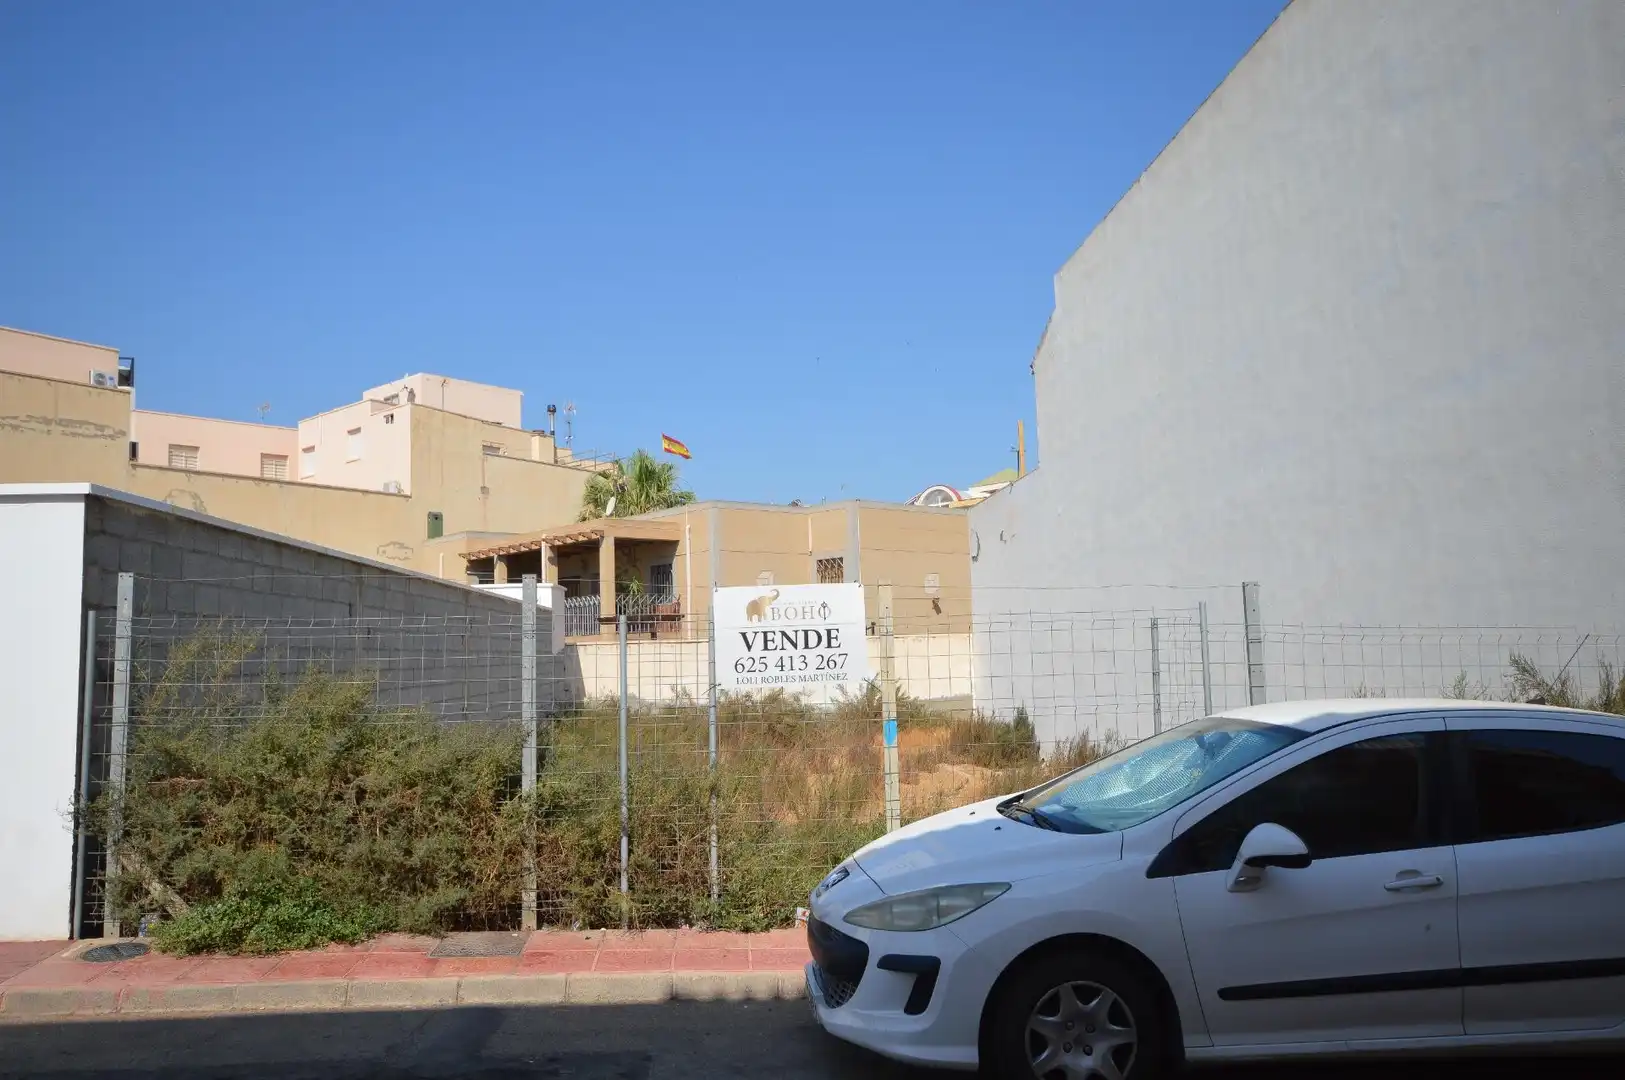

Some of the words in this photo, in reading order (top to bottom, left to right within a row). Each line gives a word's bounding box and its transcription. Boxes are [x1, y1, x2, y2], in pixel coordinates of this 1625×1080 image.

[739, 628, 841, 652] VENDE
[734, 656, 768, 674] 625
[774, 654, 808, 672] 413
[815, 653, 849, 671] 267
[736, 676, 758, 685] LOLI
[761, 674, 797, 685] ROBLES
[798, 672, 849, 683] MARTÍNEZ
